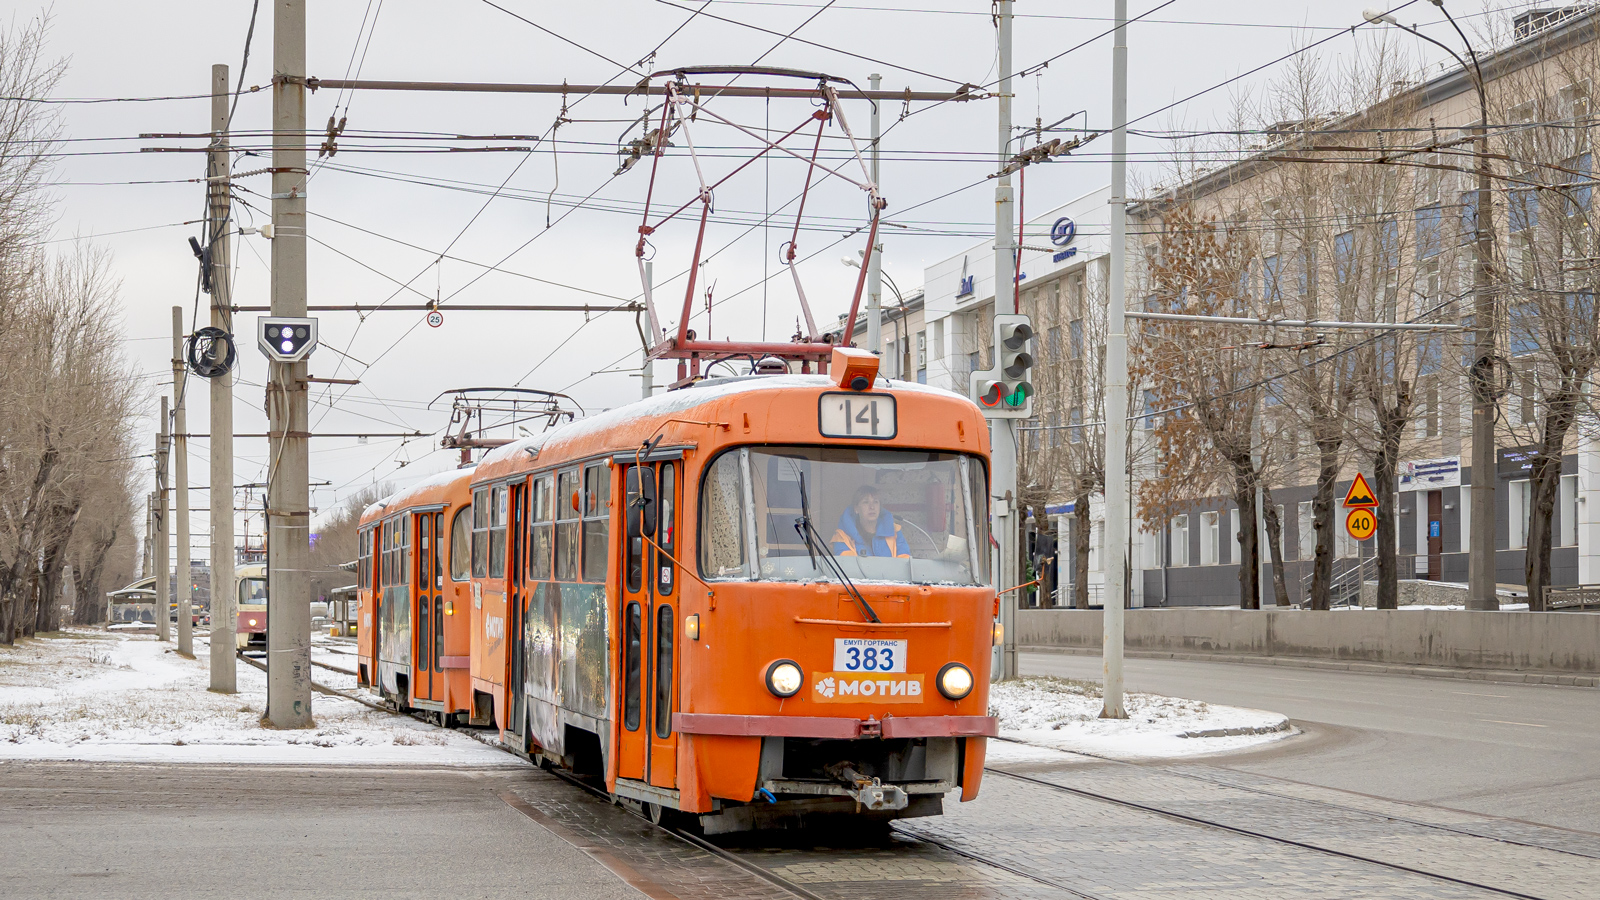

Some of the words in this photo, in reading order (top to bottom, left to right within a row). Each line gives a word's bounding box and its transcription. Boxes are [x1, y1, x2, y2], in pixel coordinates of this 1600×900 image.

[430, 315, 440, 323] 25
[839, 399, 880, 435] 14
[1351, 517, 1370, 530] 40
[863, 639, 898, 647] ГОРТРАНС
[845, 647, 894, 671] 383
[838, 680, 922, 696] МОТИВ
